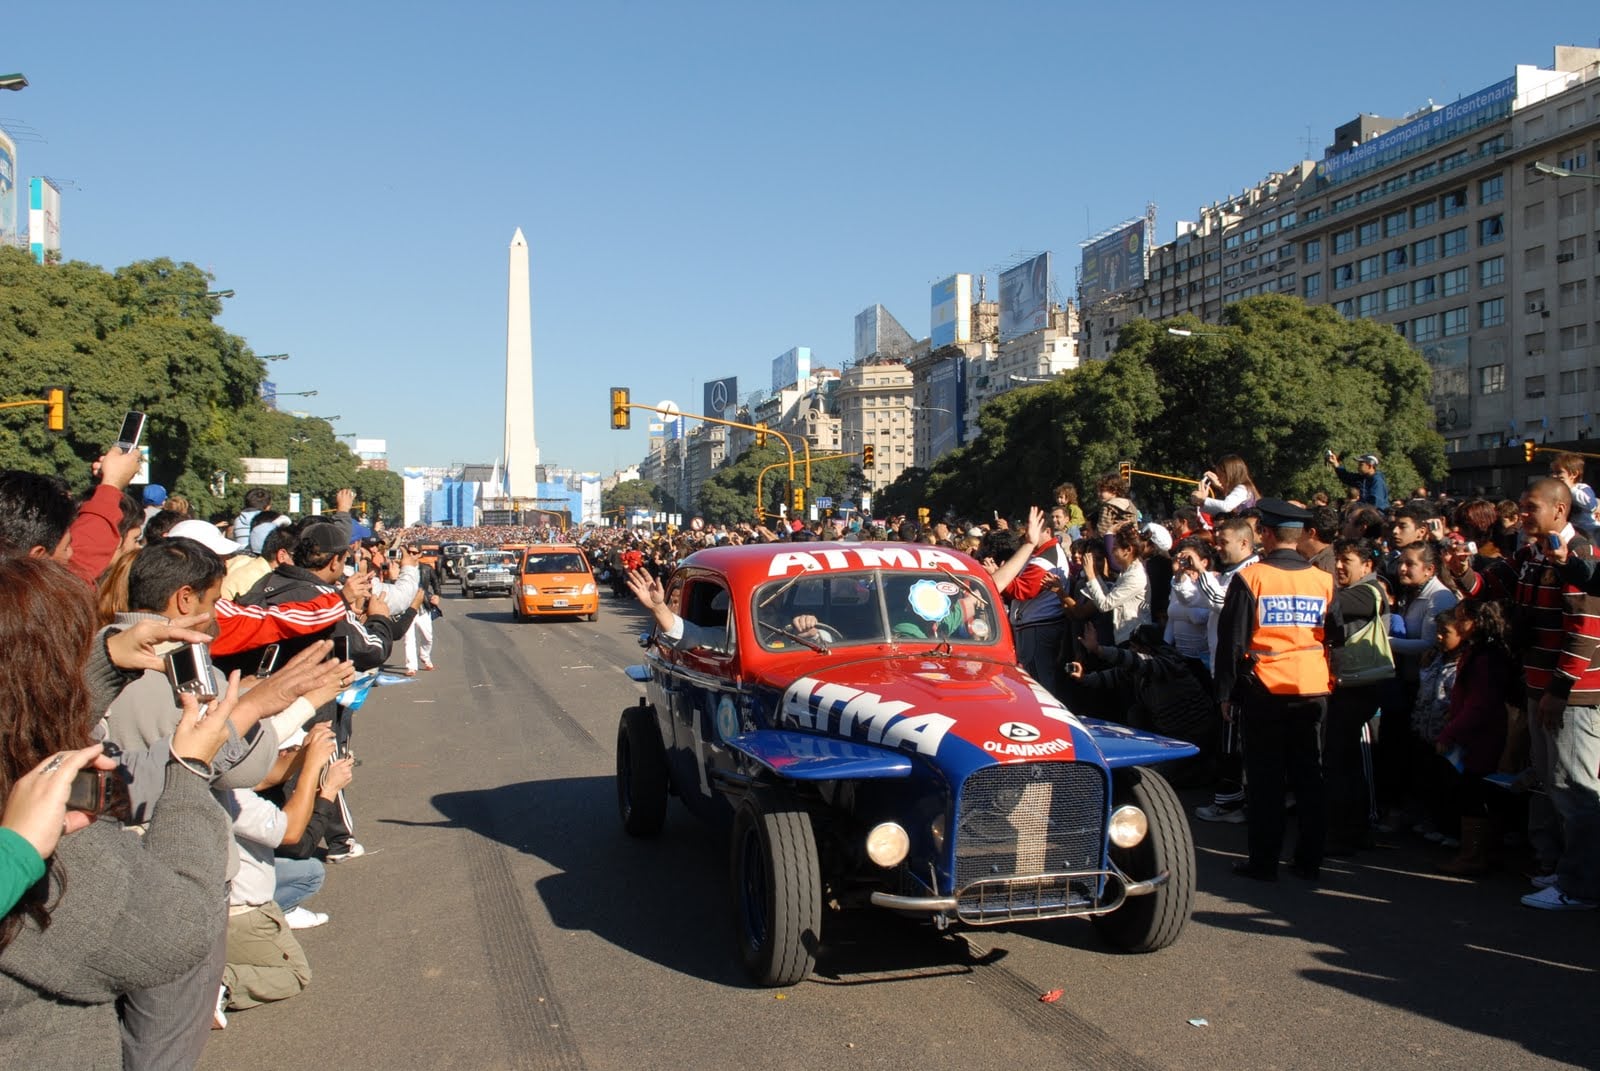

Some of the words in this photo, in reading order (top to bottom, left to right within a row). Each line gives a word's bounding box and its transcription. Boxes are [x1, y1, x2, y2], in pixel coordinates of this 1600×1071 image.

[1325, 158, 1340, 174] NH
[1343, 143, 1377, 165] Hoteles
[1380, 118, 1430, 149] acompaña
[1433, 108, 1443, 127] el
[768, 548, 969, 577] ATMA
[1266, 600, 1319, 612] POLICIA
[1266, 612, 1318, 623] FEDERAL
[774, 676, 958, 757] ATMA
[983, 738, 1073, 757] OLAVARRIA
